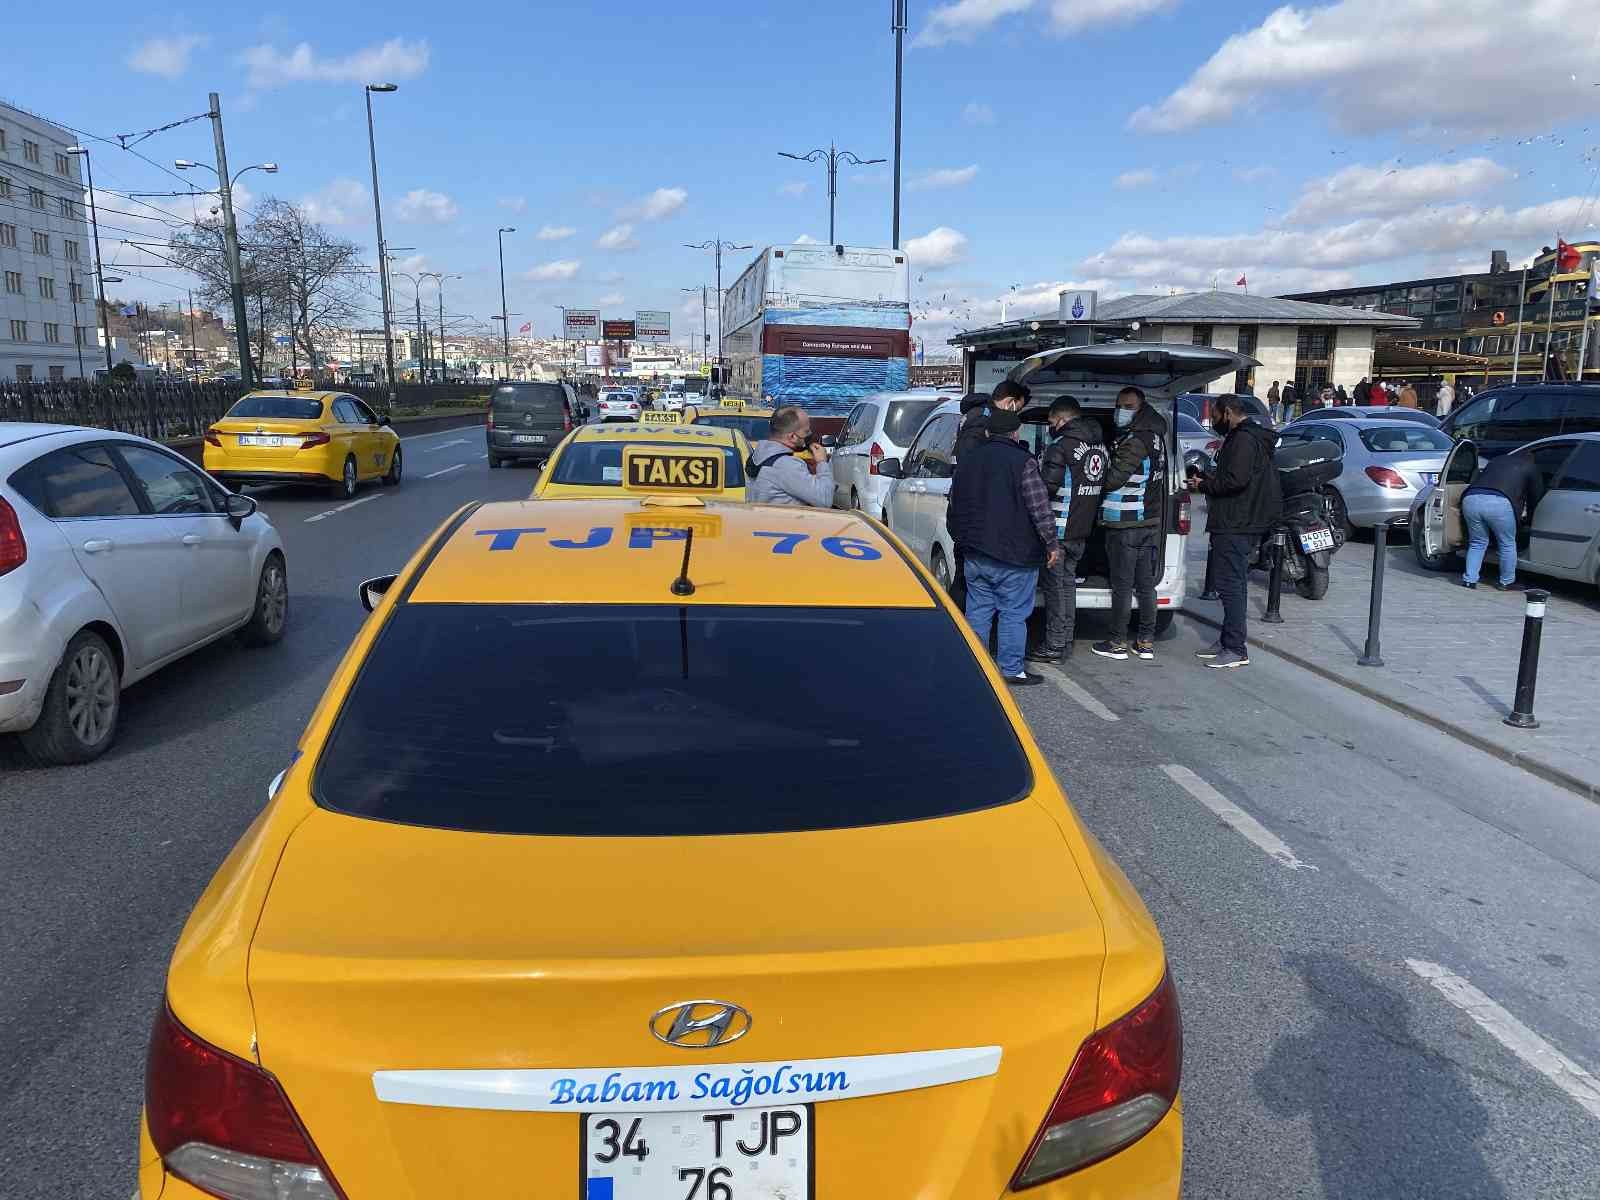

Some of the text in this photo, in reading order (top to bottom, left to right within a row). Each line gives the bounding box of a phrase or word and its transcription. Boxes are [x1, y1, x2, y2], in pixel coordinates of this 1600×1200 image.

[802, 341, 831, 350] Connecting
[832, 342, 849, 350] Europe
[475, 526, 883, 561] TJP 76
[549, 1065, 850, 1106] Babam Sağolsun
[593, 1110, 802, 1164] 34 TJP
[678, 1166, 734, 1200] 76
